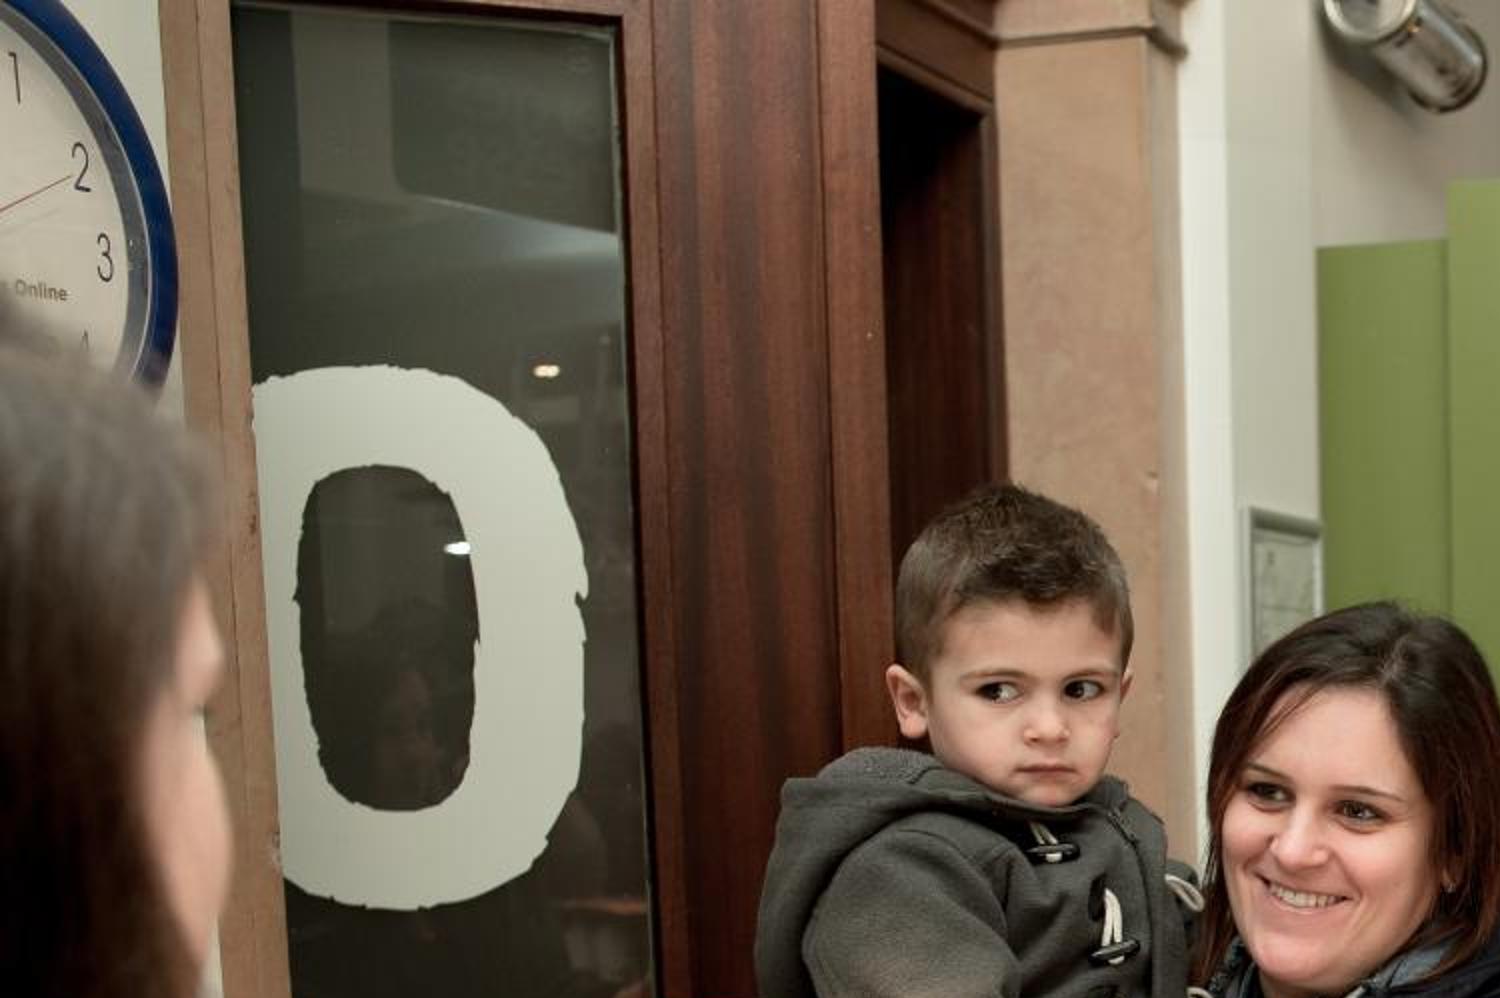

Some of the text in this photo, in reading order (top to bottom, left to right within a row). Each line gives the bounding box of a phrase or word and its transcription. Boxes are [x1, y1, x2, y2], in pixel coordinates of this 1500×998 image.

[8, 51, 22, 103] 1
[71, 141, 92, 193] 2
[96, 233, 115, 283] 3
[16, 279, 68, 302] Online
